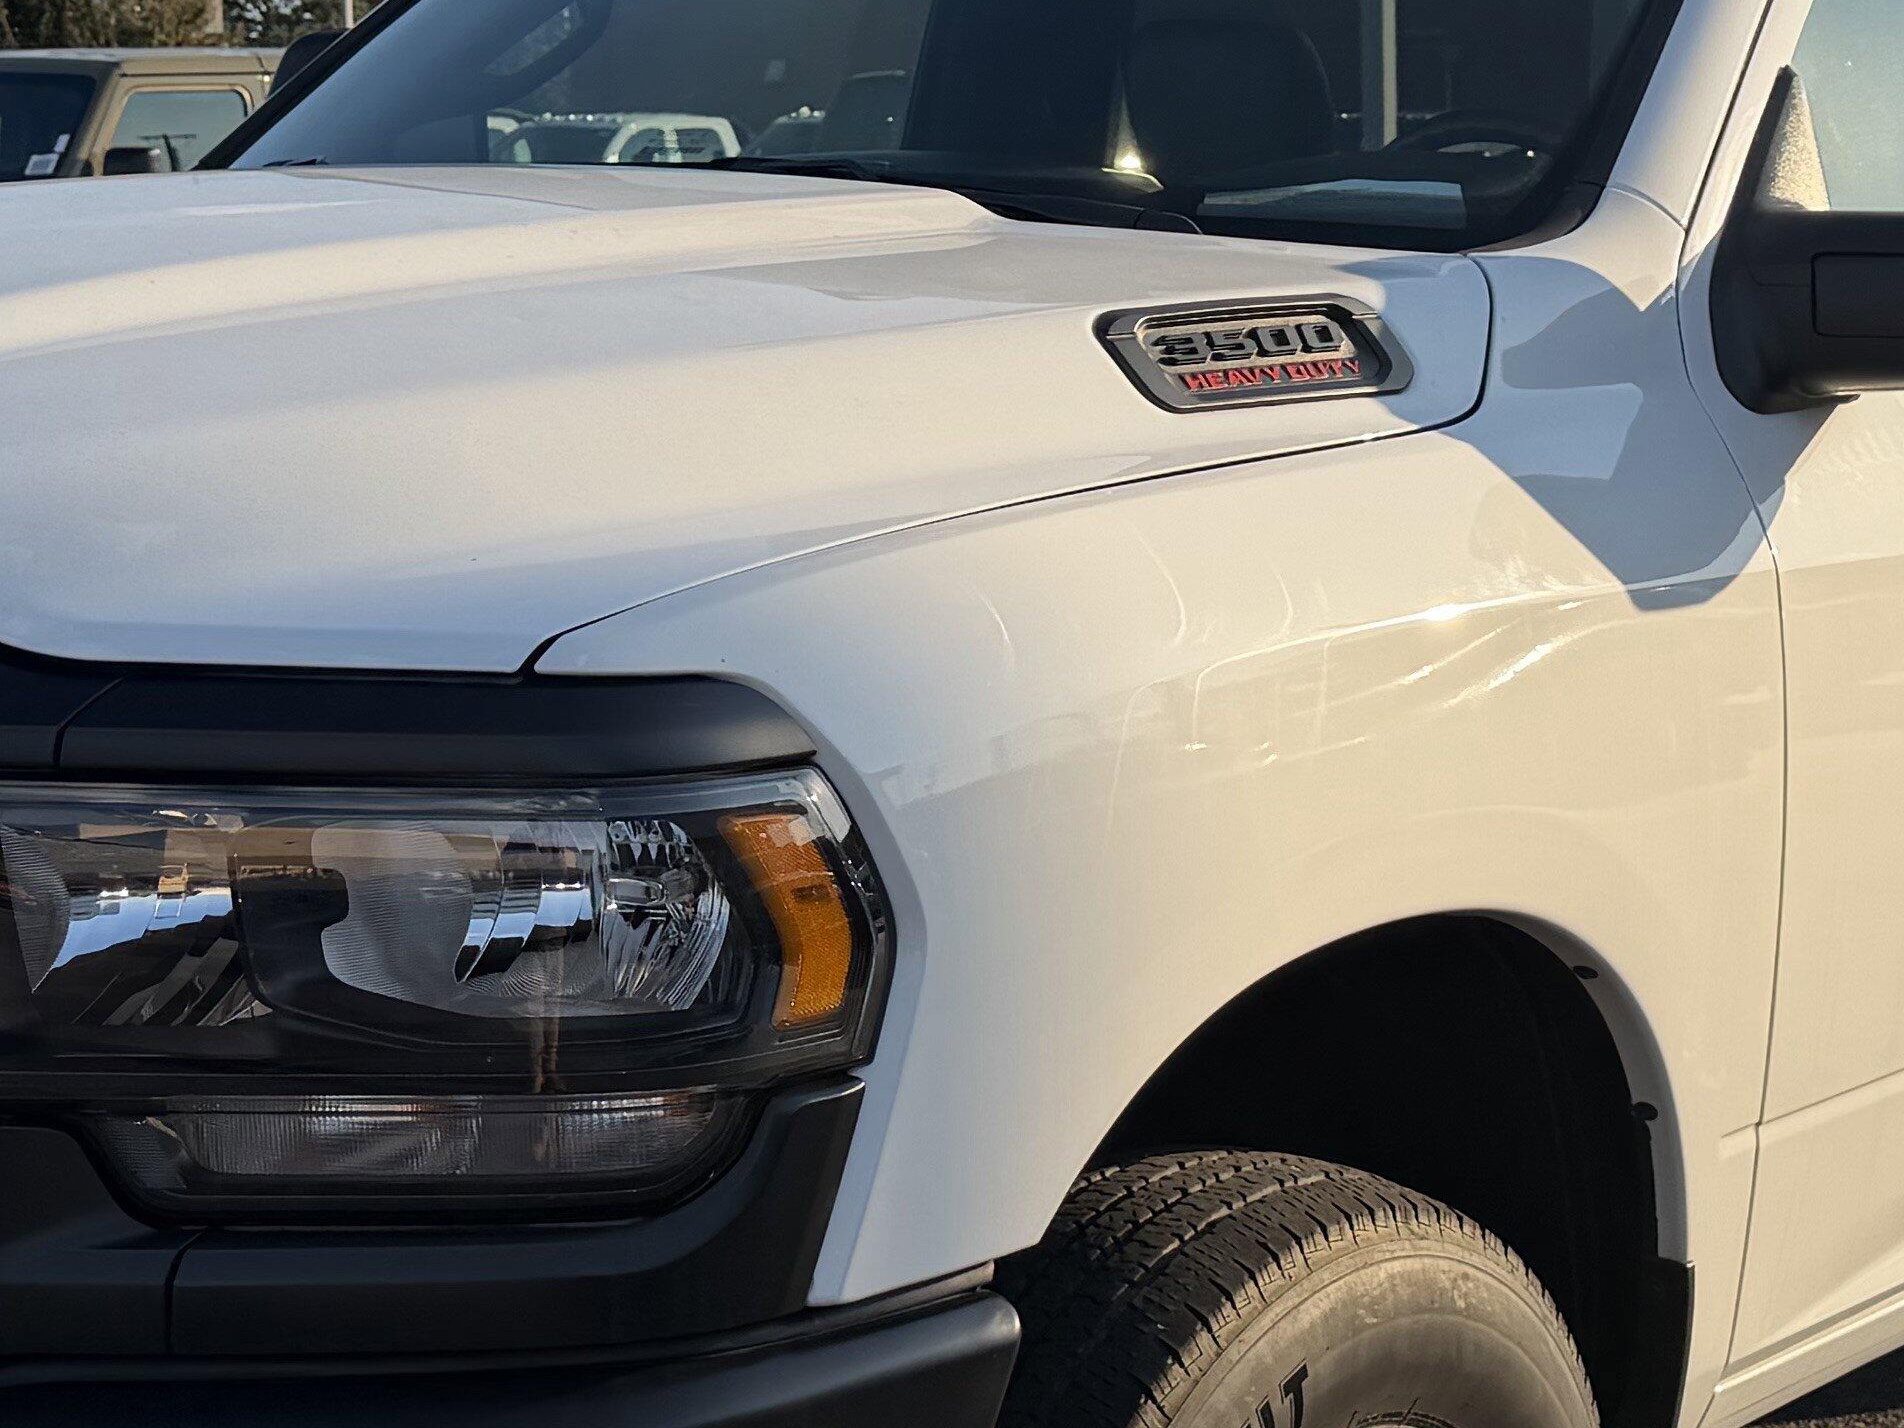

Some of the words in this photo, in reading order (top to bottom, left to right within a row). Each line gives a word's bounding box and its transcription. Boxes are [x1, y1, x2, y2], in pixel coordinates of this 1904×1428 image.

[1149, 322, 1347, 368] 3500
[1179, 365, 1281, 392] HEAVY
[1279, 359, 1363, 381] DUTY
